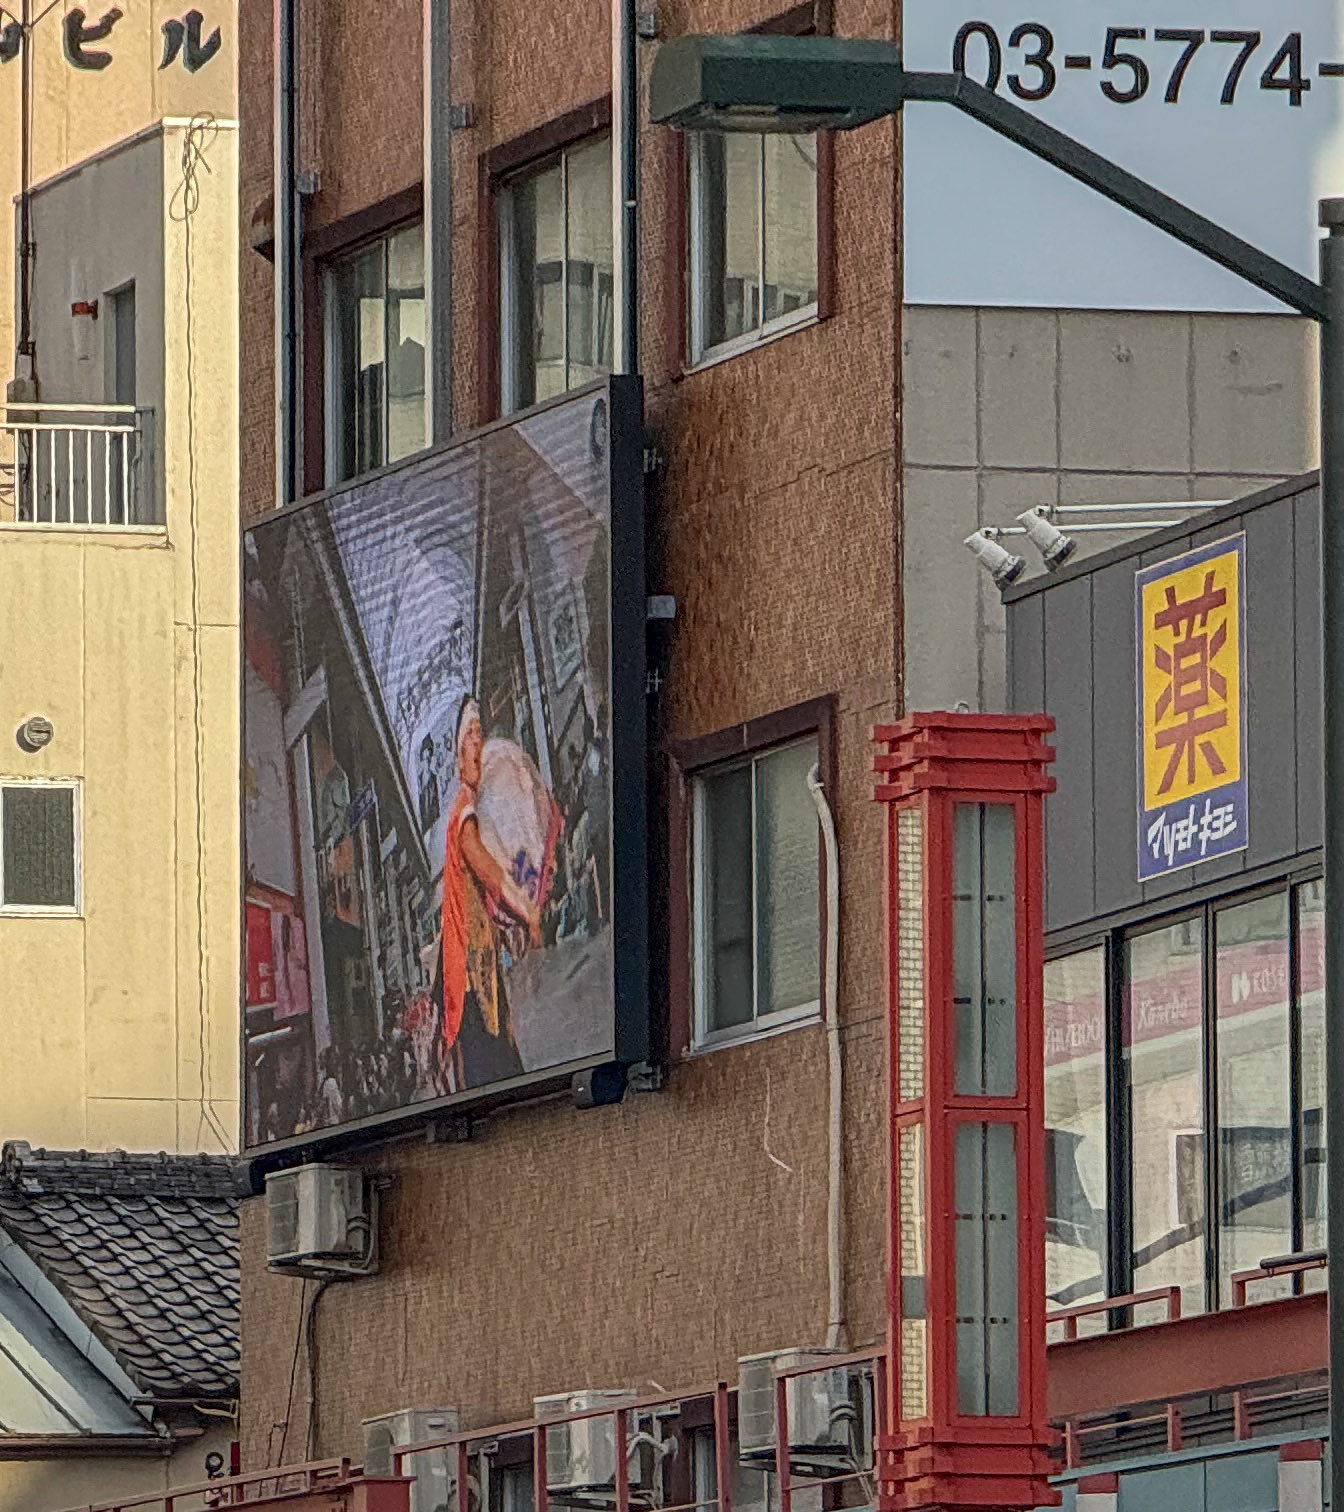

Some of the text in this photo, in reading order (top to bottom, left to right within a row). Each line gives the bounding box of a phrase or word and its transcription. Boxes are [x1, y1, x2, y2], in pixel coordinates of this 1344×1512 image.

[953, 20, 1344, 107] 03-5774-
[1154, 569, 1228, 796] 薬
[1147, 798, 1237, 866] マツモトキヨシ
